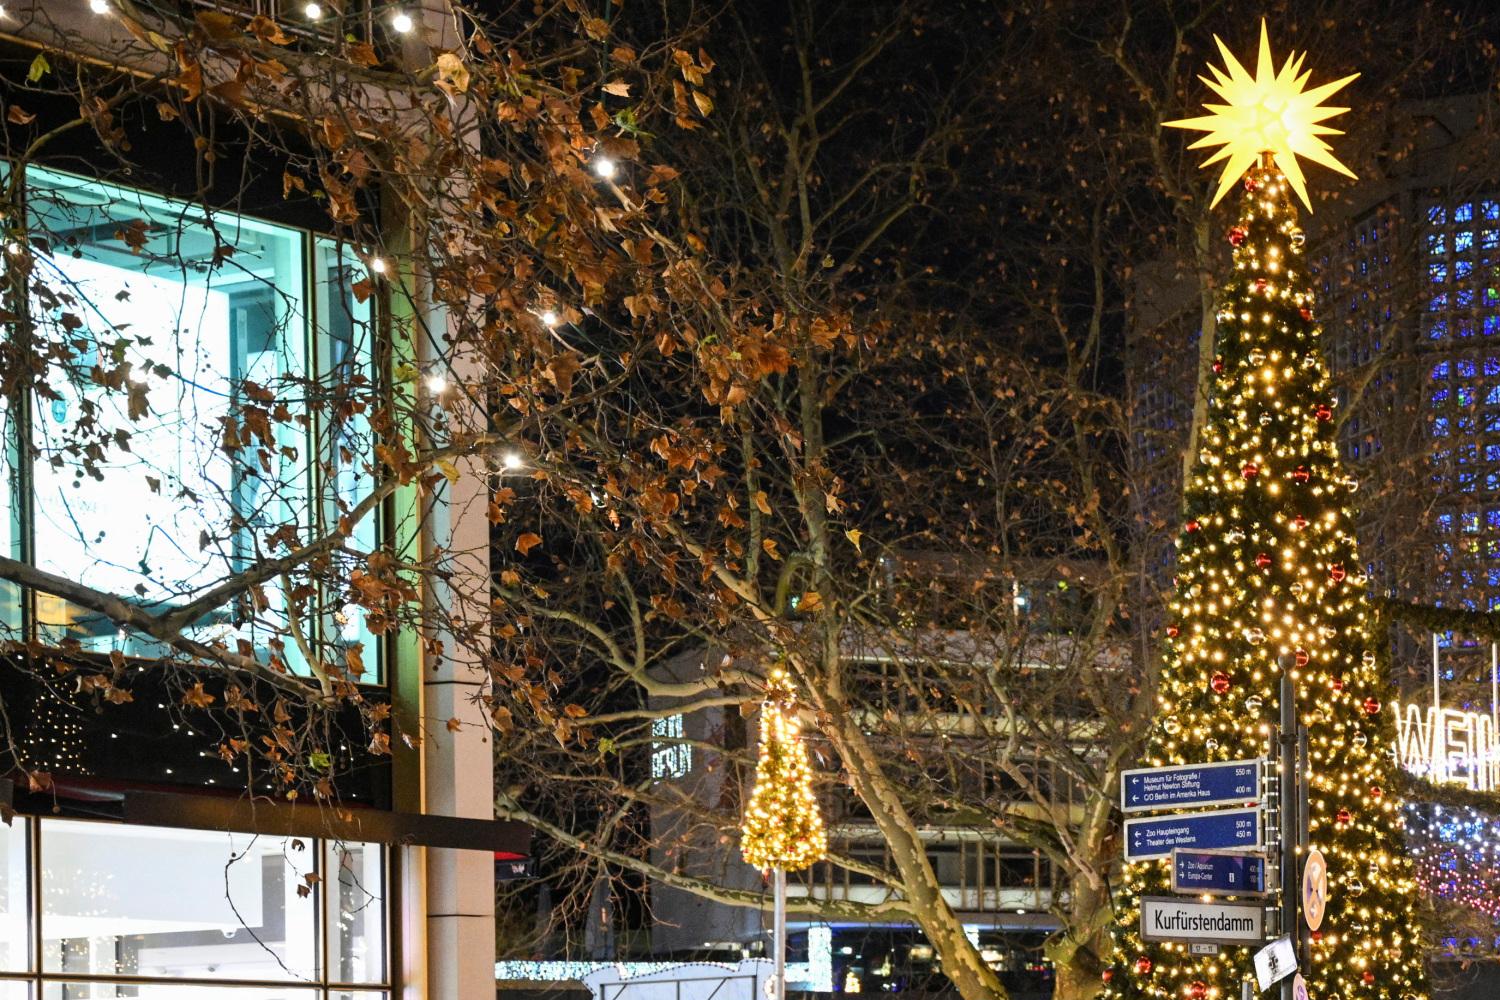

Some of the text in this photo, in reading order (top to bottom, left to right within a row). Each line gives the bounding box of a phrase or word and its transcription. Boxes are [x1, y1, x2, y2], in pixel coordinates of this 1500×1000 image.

[1144, 776, 1165, 784] Museum
[1173, 773, 1198, 783] Fotografie
[1144, 780, 1200, 792] Helmut Newton Stiftung
[1155, 792, 1169, 801] Berlin
[1169, 791, 1176, 799] im
[1176, 790, 1197, 799] Amerika
[1198, 789, 1211, 797] Haus
[1235, 786, 1246, 794] 400
[1146, 829, 1156, 837] Zoo
[1156, 826, 1190, 837] Haupteingang
[1236, 820, 1246, 828] 500
[1147, 838, 1165, 847] Theater
[1165, 837, 1175, 845] des
[1175, 835, 1196, 844] Westens
[1155, 909, 1254, 932] Kurfürstendamm
